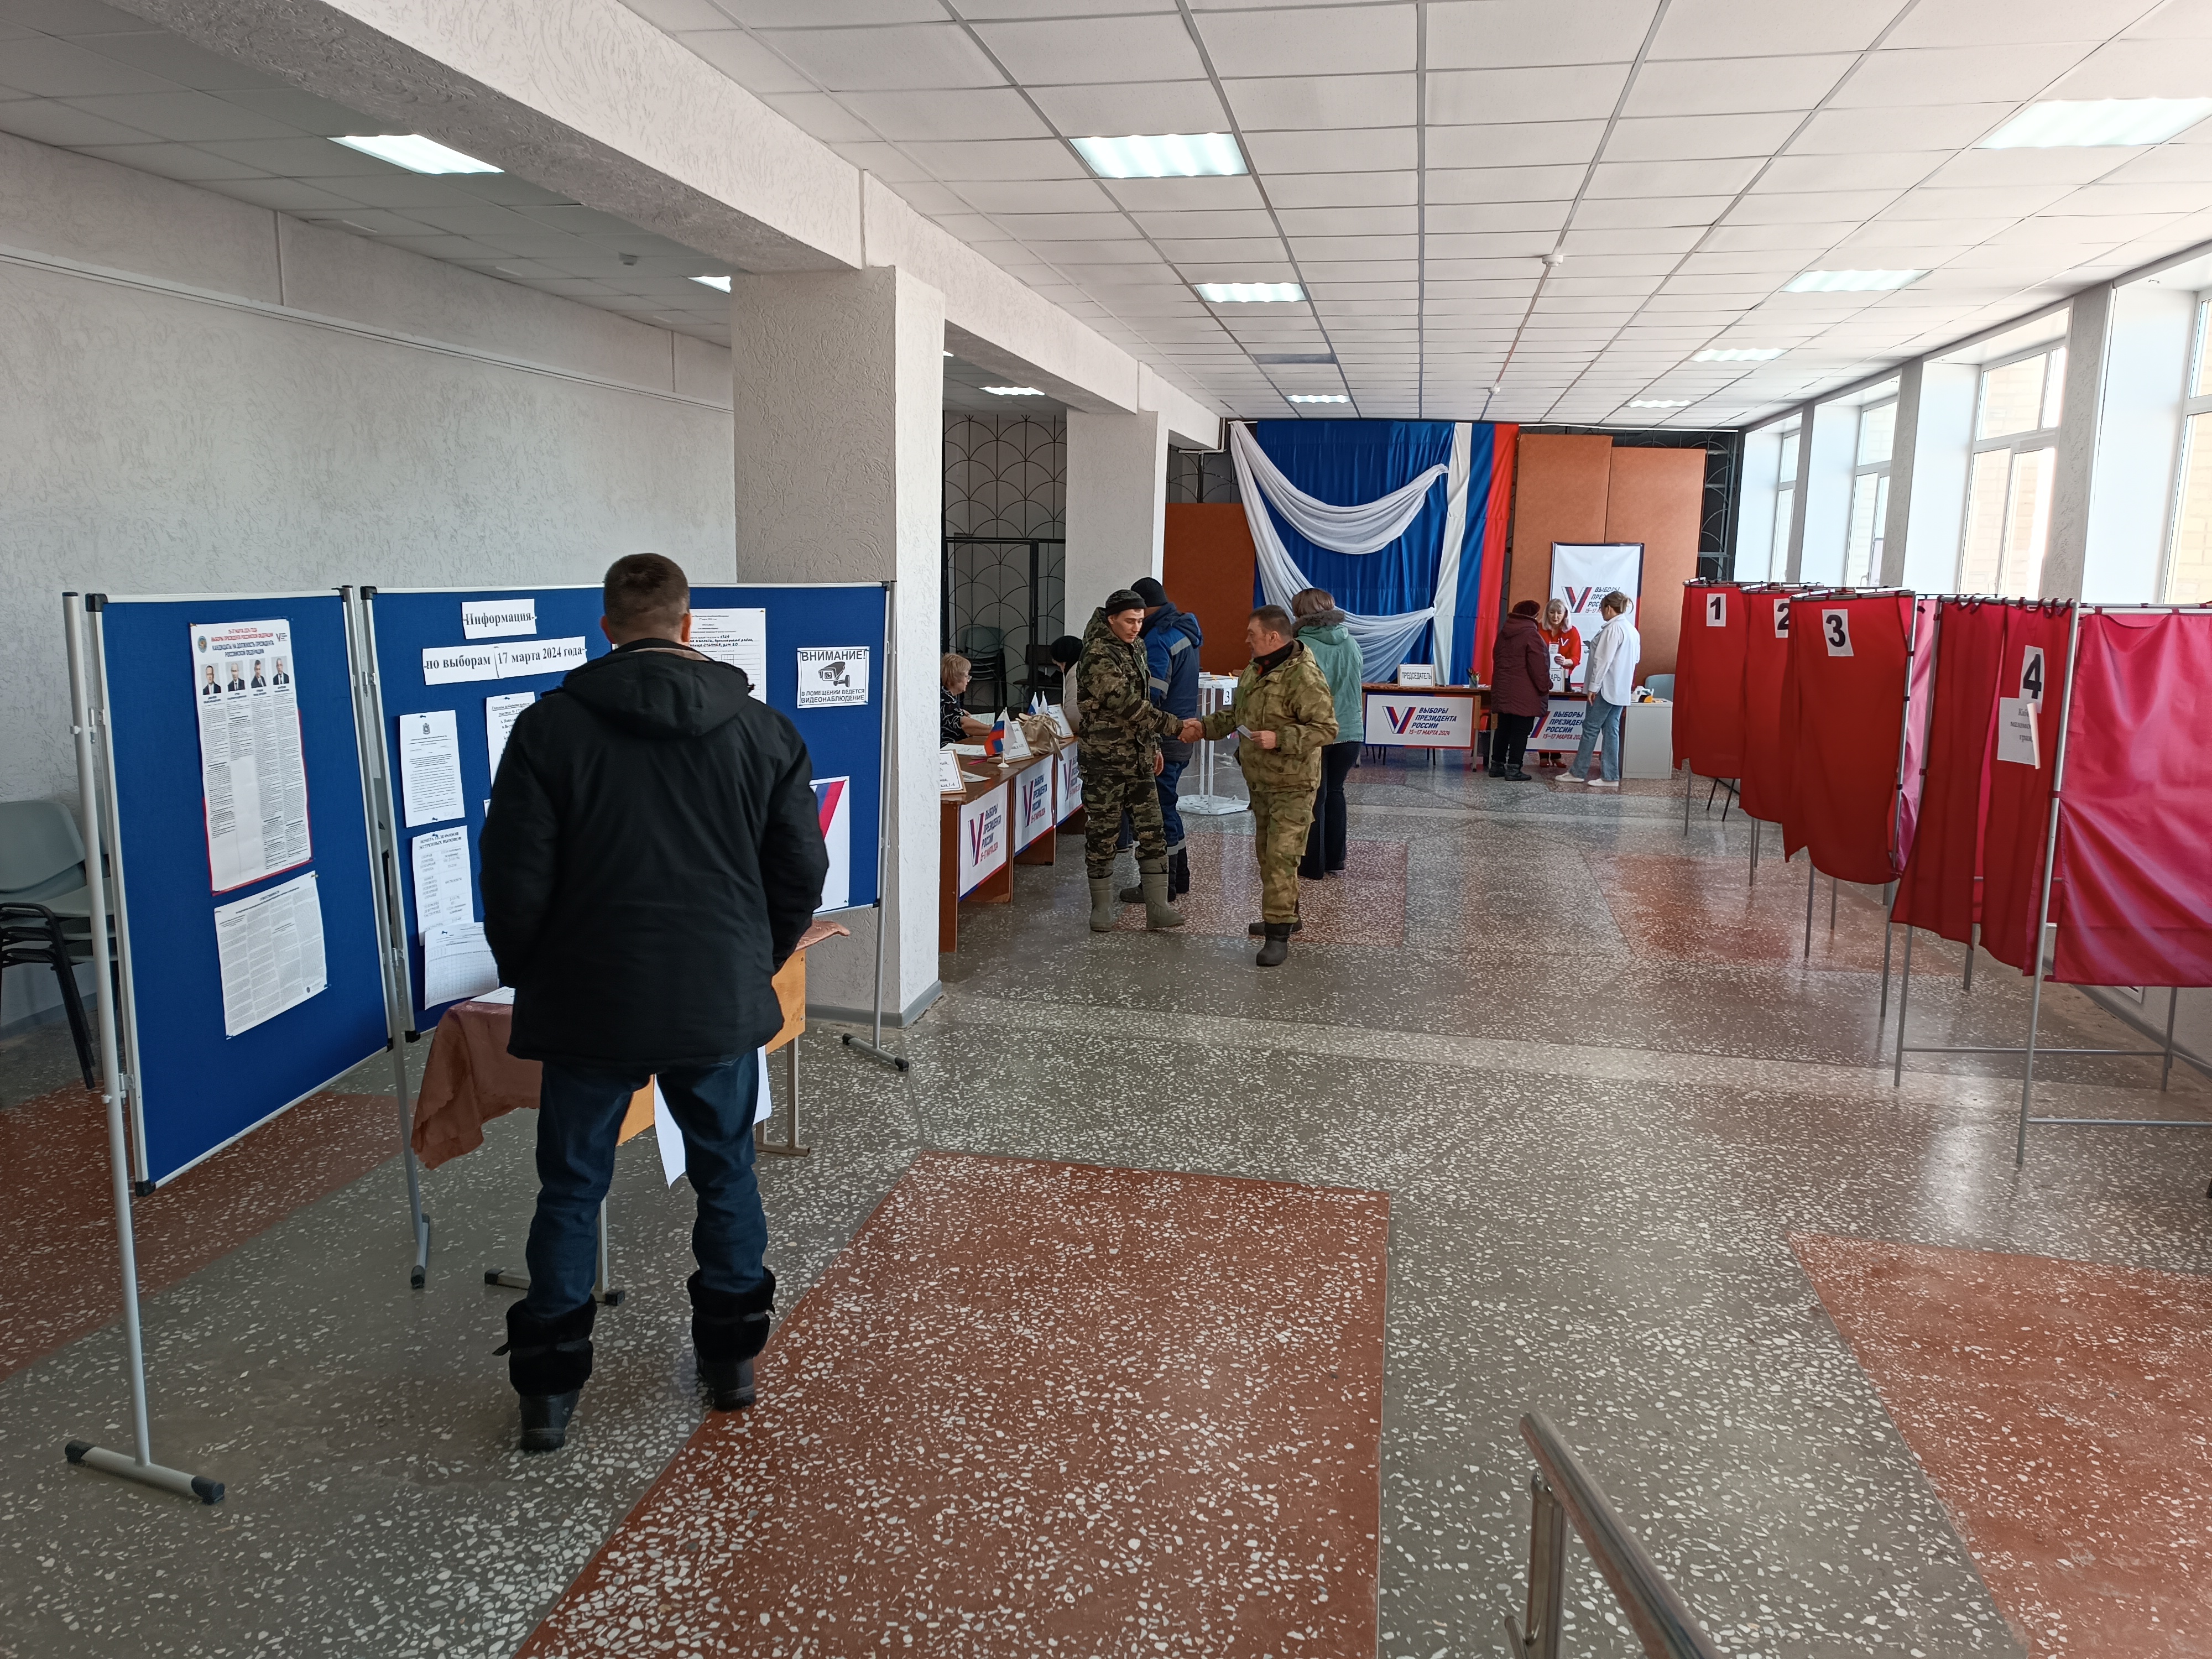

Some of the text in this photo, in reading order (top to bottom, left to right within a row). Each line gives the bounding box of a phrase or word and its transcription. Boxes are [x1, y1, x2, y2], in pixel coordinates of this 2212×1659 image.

[1710, 597, 1721, 620] 1
[1777, 602, 1790, 630] 2
[465, 612, 532, 628] Информация
[1825, 614, 1846, 648] 3
[425, 646, 582, 669] по выборам 17 марта 2024 года
[801, 650, 866, 661] ВНИМАНИЕ!
[1402, 672, 1432, 680] ПРЕДСЕДАТЕЛЬ
[2022, 654, 2042, 699] 4
[801, 695, 864, 703] ВИДЕОНАБЛЮДЕНИЕ
[1225, 691, 1230, 703] 3
